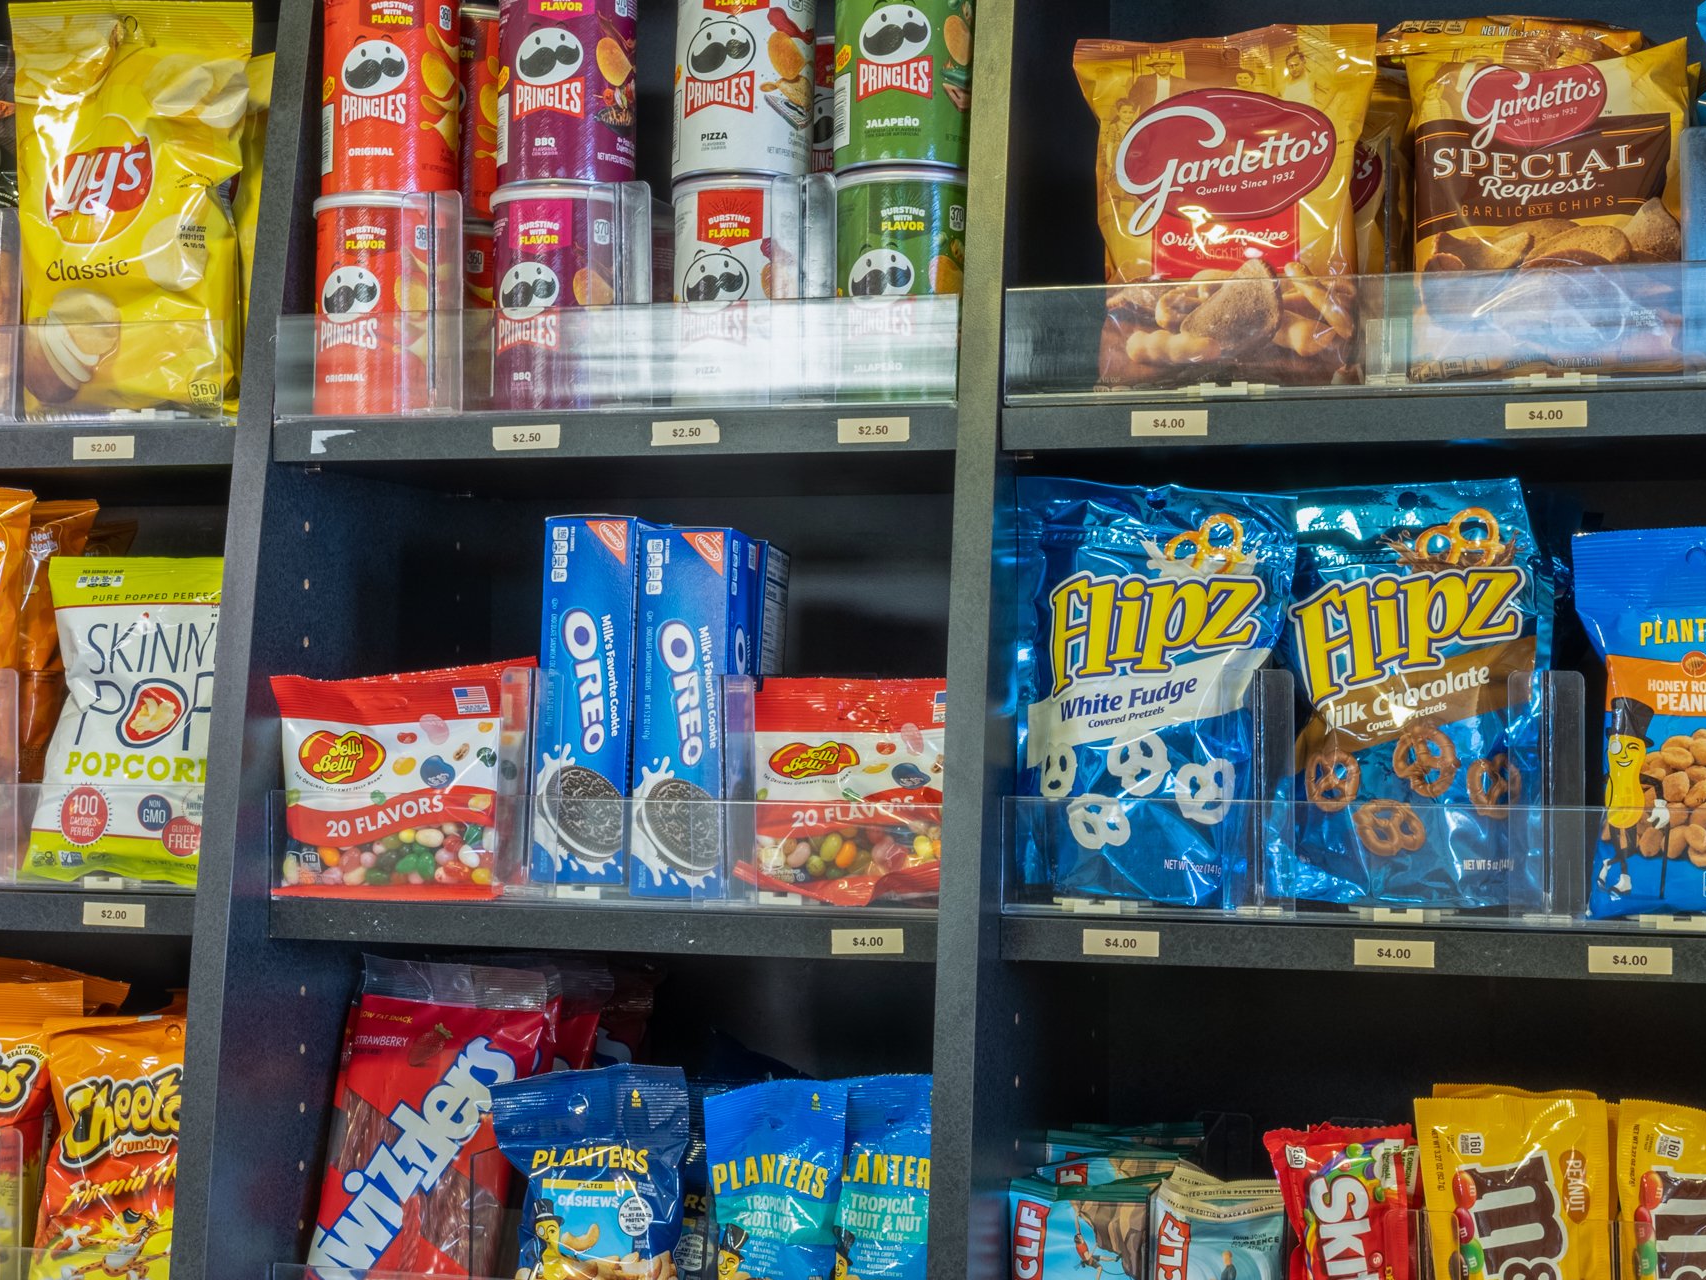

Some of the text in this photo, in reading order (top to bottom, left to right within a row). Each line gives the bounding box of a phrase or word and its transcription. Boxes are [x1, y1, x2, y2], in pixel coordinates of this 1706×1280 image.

[541, 1, 583, 12] FLAVOR
[515, 80, 582, 115] PRINGLES
[687, 74, 753, 114] PRINGLES
[341, 94, 406, 125] PRINGLES
[1461, 65, 1600, 149] Gardetto's
[866, 116, 920, 128] JALAPEÑO
[535, 138, 555, 147] BBQ
[700, 132, 727, 142] PIZZA
[348, 147, 393, 156] ORIGINAL
[1123, 106, 1330, 236] Gardetto's
[1432, 147, 1644, 181] SPECIAL
[1196, 171, 1295, 196] Quality Since 1932
[1480, 171, 1596, 200] Request
[1461, 197, 1614, 218] GARLIC RYE CHIPS
[46, 257, 129, 282] Classic
[1528, 410, 1562, 421] $4.00
[858, 425, 888, 435] $2.50
[91, 443, 116, 452] $2.00
[1052, 575, 1261, 695] Flipz
[565, 609, 604, 754] OREO
[1648, 680, 1688, 695] HONEY
[1060, 674, 1197, 720] White Fudge
[1088, 705, 1165, 728] Covered Pretzels
[333, 739, 364, 761] Jelly
[314, 755, 357, 778] Belly
[69, 795, 98, 815] 100
[327, 795, 444, 838] 20 FLAVORS
[853, 936, 883, 947] $4.00
[354, 1035, 408, 1046] STRAWBERRY
[532, 1147, 650, 1173] PLANTERS
[1566, 1156, 1583, 1214] PEANUT
[557, 1194, 619, 1208] CASHEWS
[1015, 1206, 1045, 1275] CLIF
